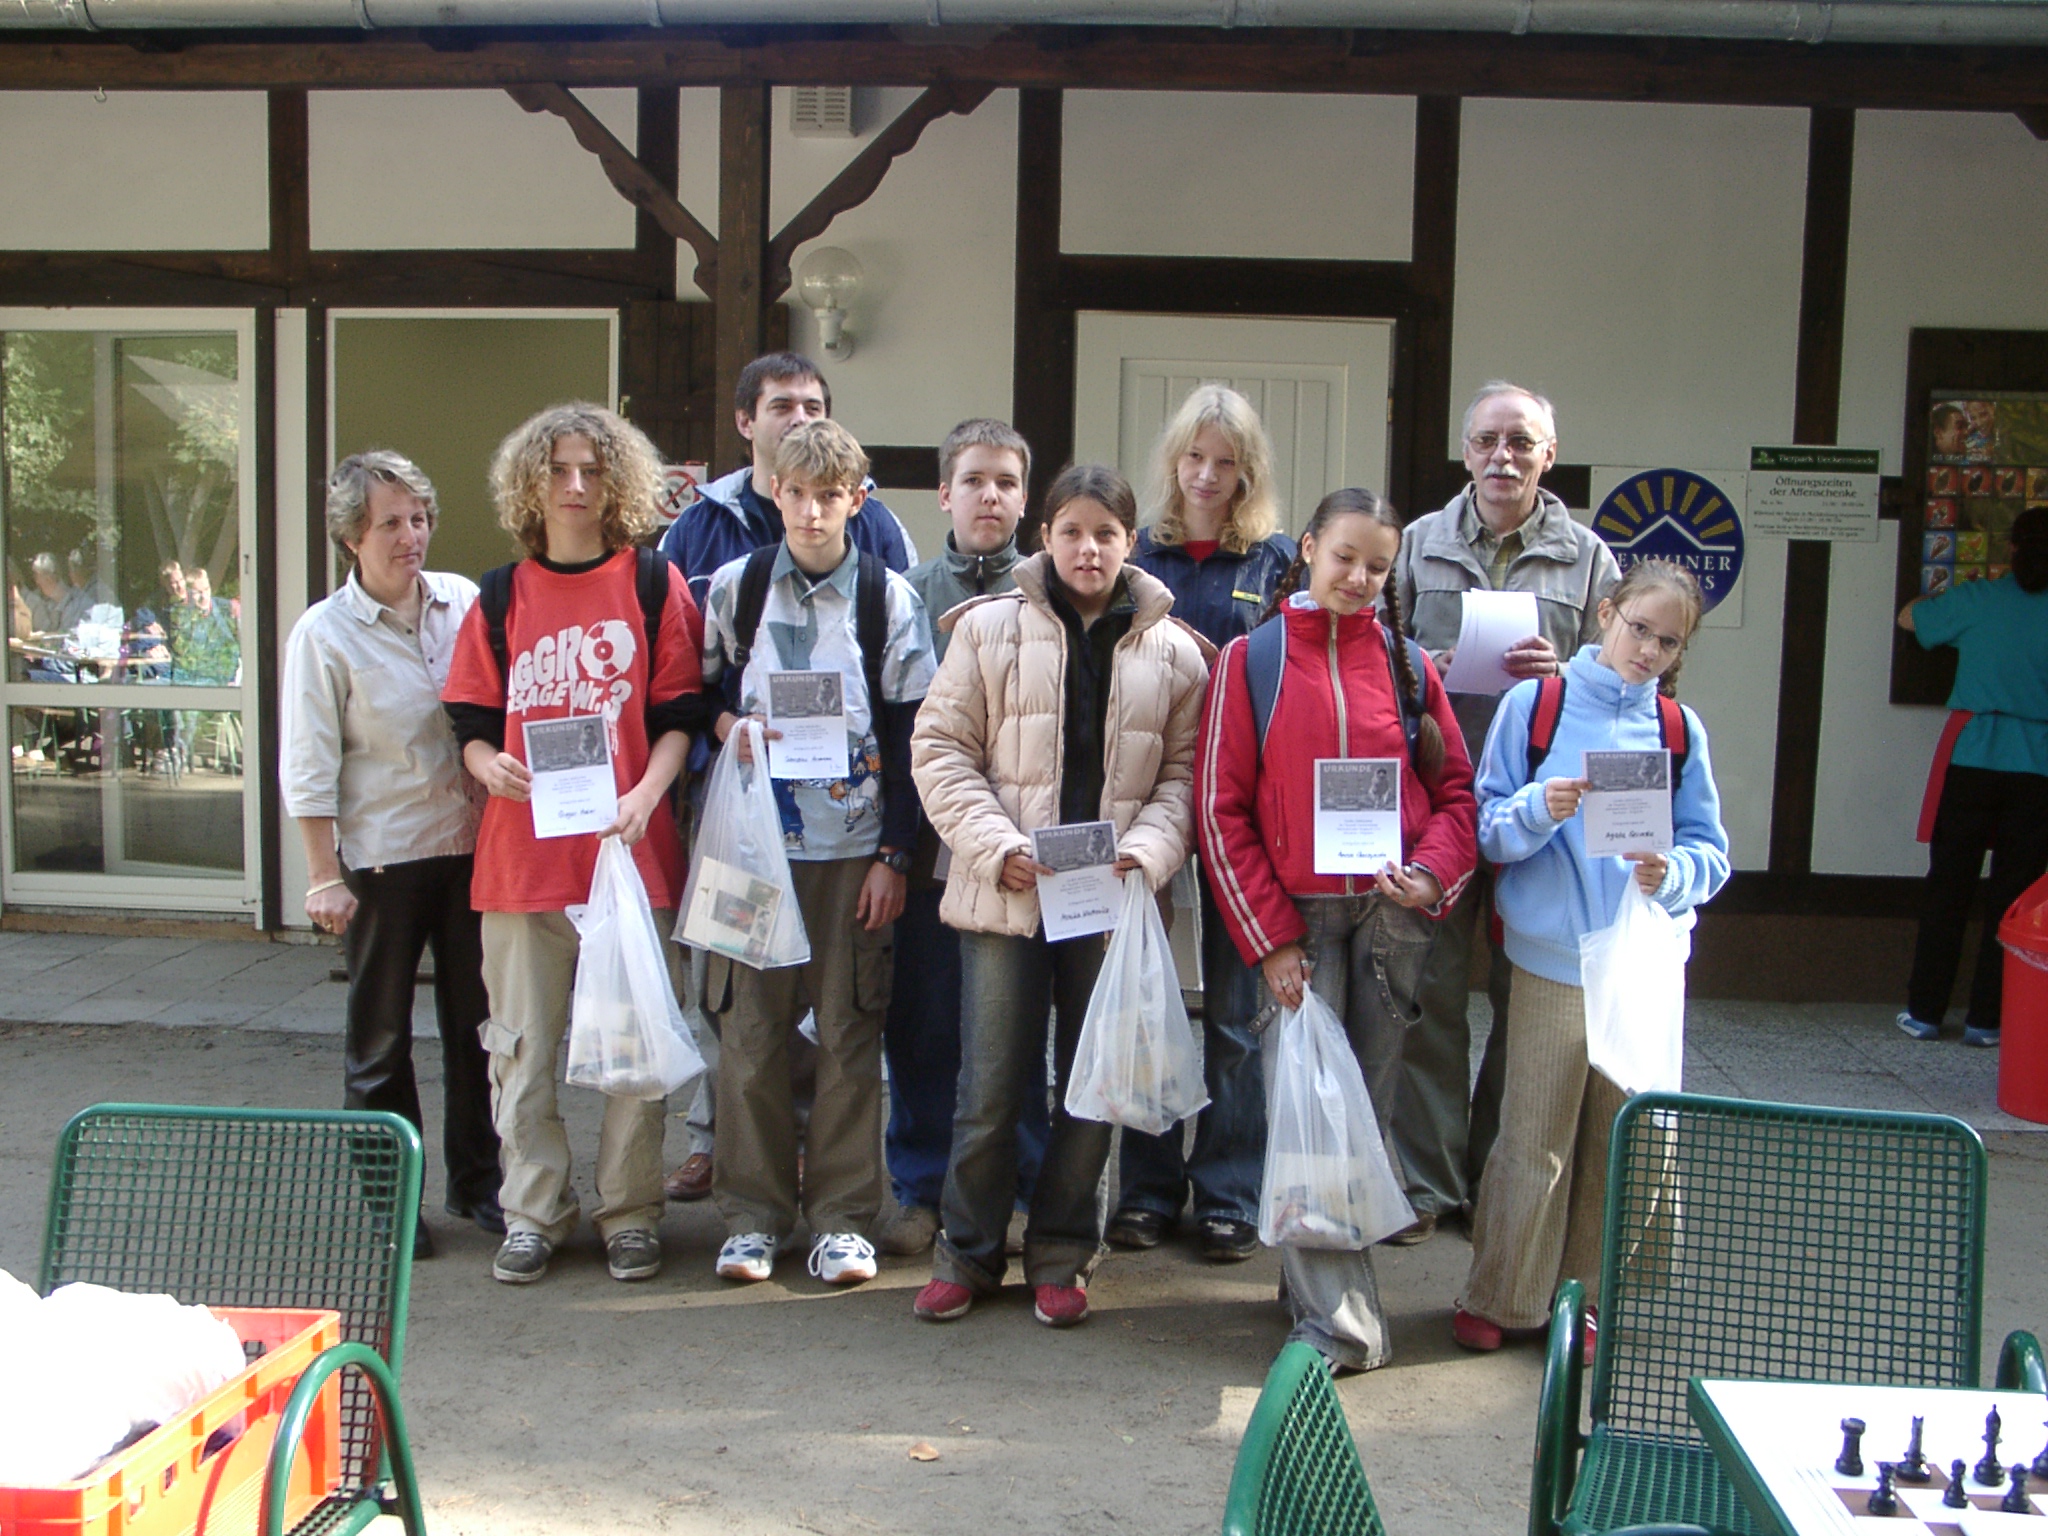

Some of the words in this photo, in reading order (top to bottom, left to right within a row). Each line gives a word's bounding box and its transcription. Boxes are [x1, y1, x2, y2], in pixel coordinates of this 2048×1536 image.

[1775, 475, 1852, 488] Öffnungszeiten
[1769, 487, 1786, 496] der
[1789, 487, 1857, 498] Affenschenke
[772, 674, 817, 683] URKUNDE
[530, 722, 580, 735] URKUNDE
[1323, 764, 1372, 773] URKUNDE
[1039, 827, 1087, 839] URKUNDE
